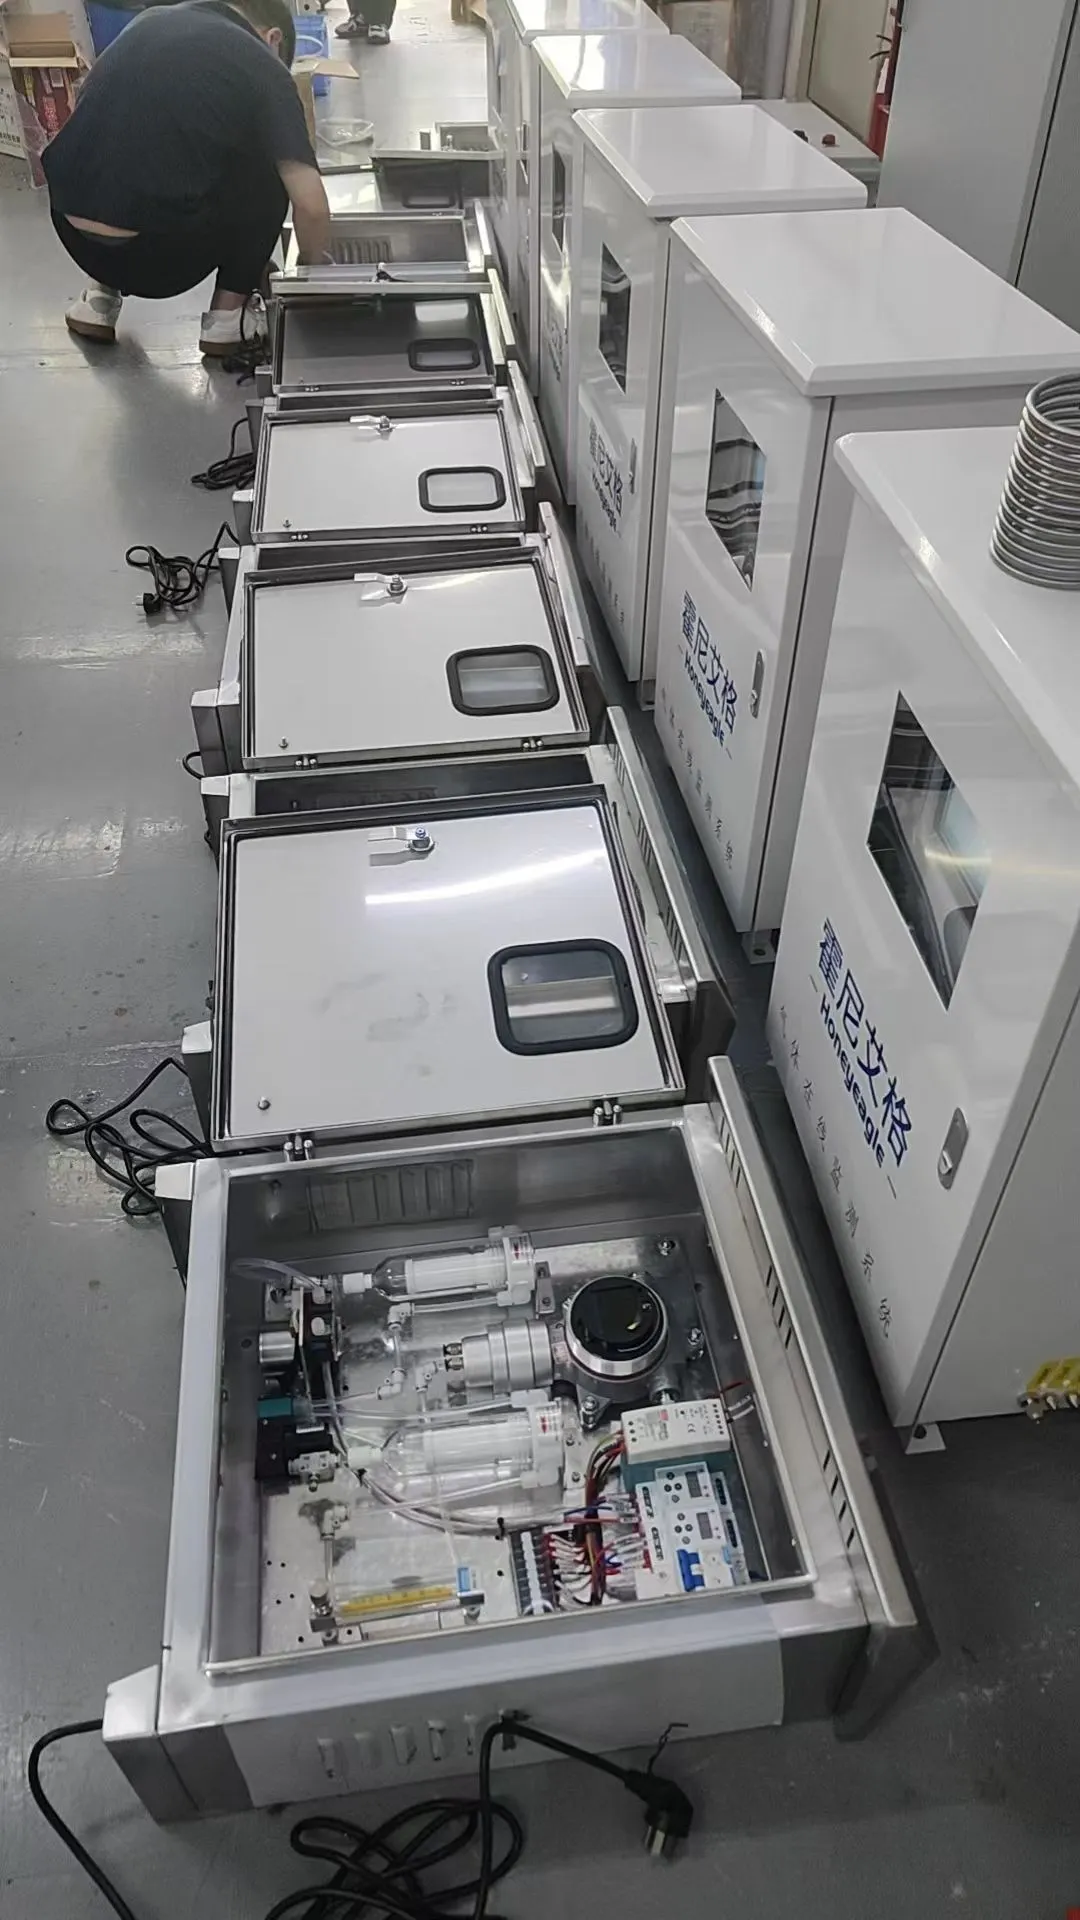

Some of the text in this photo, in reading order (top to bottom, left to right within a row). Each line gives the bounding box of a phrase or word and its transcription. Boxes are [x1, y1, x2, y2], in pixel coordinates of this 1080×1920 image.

[682, 590, 738, 735] 霍尼艾格
[684, 652, 725, 748] Honeyeagle
[818, 917, 914, 1168] 霍尼艾格
[820, 992, 886, 1169] Honeyeagle
